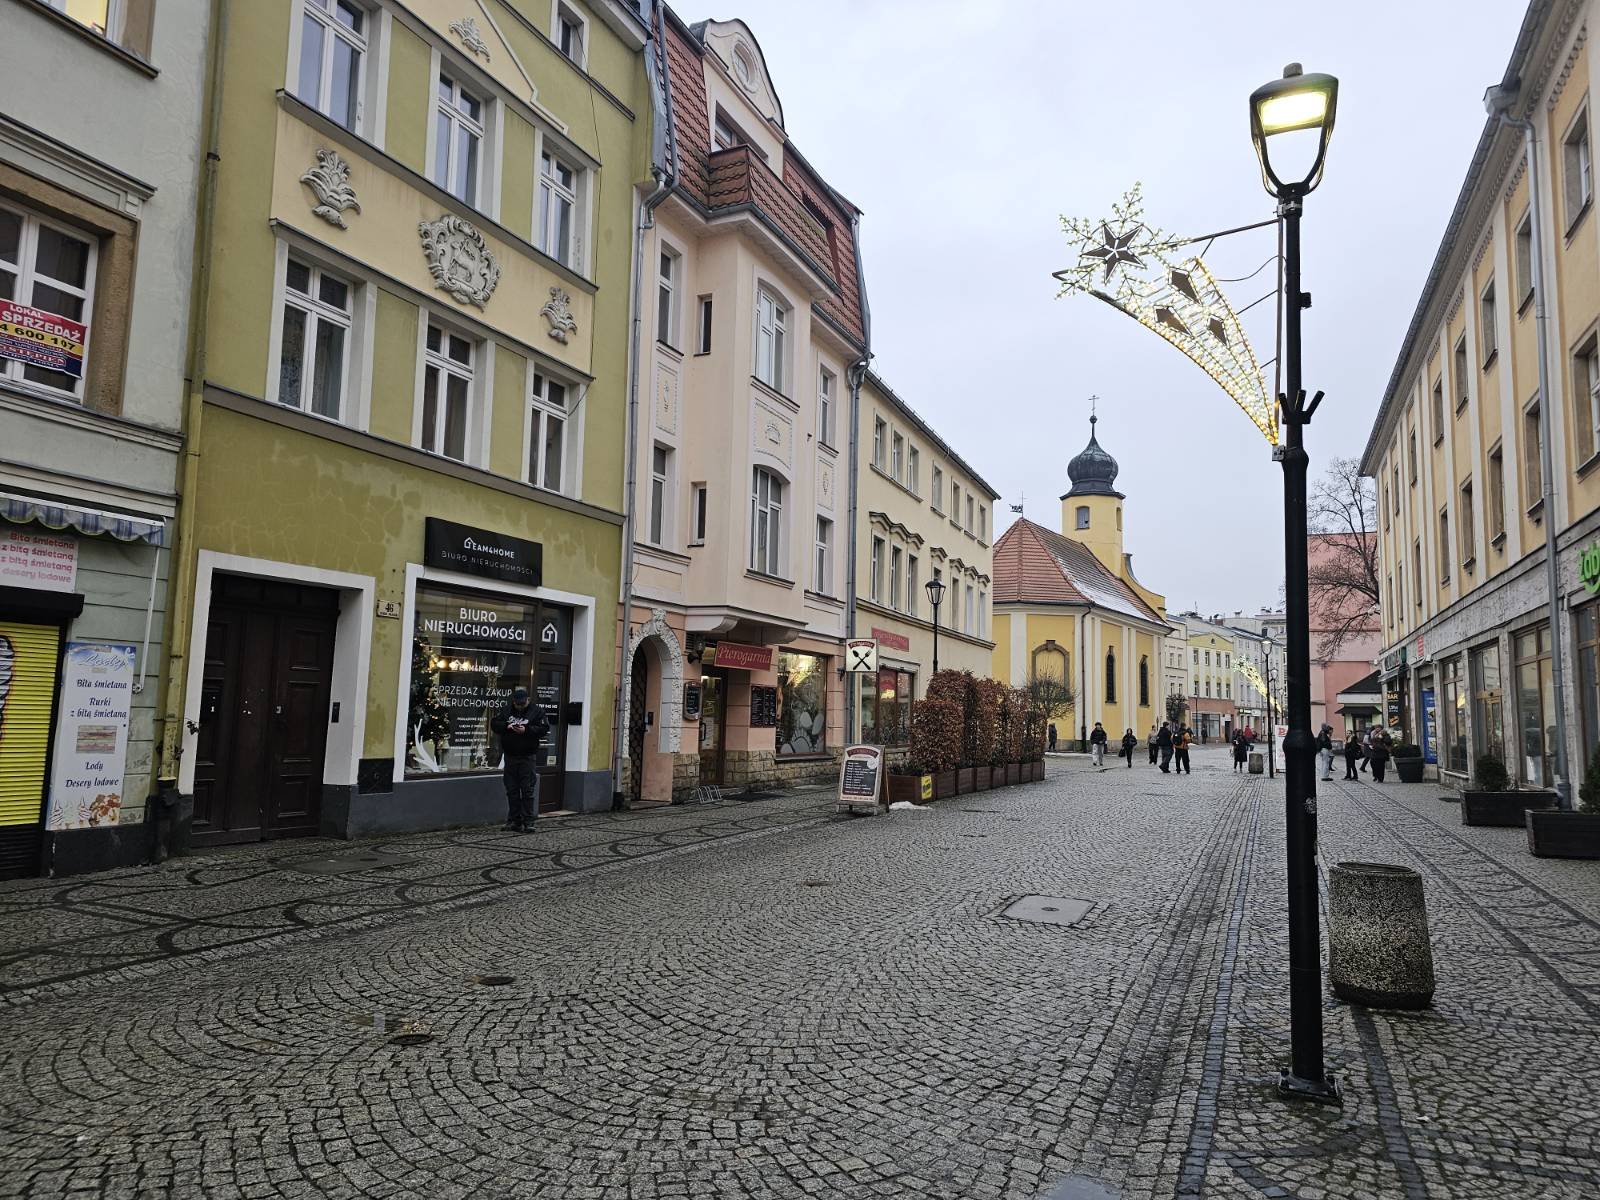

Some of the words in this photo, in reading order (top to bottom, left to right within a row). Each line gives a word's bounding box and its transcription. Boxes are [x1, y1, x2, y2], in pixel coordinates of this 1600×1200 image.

[9, 303, 44, 319] LOKAL
[1, 310, 81, 342] SPRZEDAŻ
[14, 327, 45, 341] 600
[10, 530, 30, 541] Bita
[31, 547, 74, 562] śmietaną
[441, 551, 468, 562] BIURO
[30, 558, 73, 574] śmietaną
[385, 602, 394, 612] 46
[459, 608, 497, 623] BIURO
[424, 619, 526, 641] NIERUCHOMOŚCI
[718, 646, 771, 665] Pierogarnia
[77, 678, 92, 688] Bita
[94, 679, 127, 689] śmietana
[486, 687, 512, 697] ZAKUP
[89, 696, 112, 706] Rurki
[76, 707, 92, 719] bitą
[93, 708, 127, 719] śmietaną
[85, 760, 104, 771] Lody
[65, 779, 92, 789] Desery
[94, 777, 120, 787] lodowe
